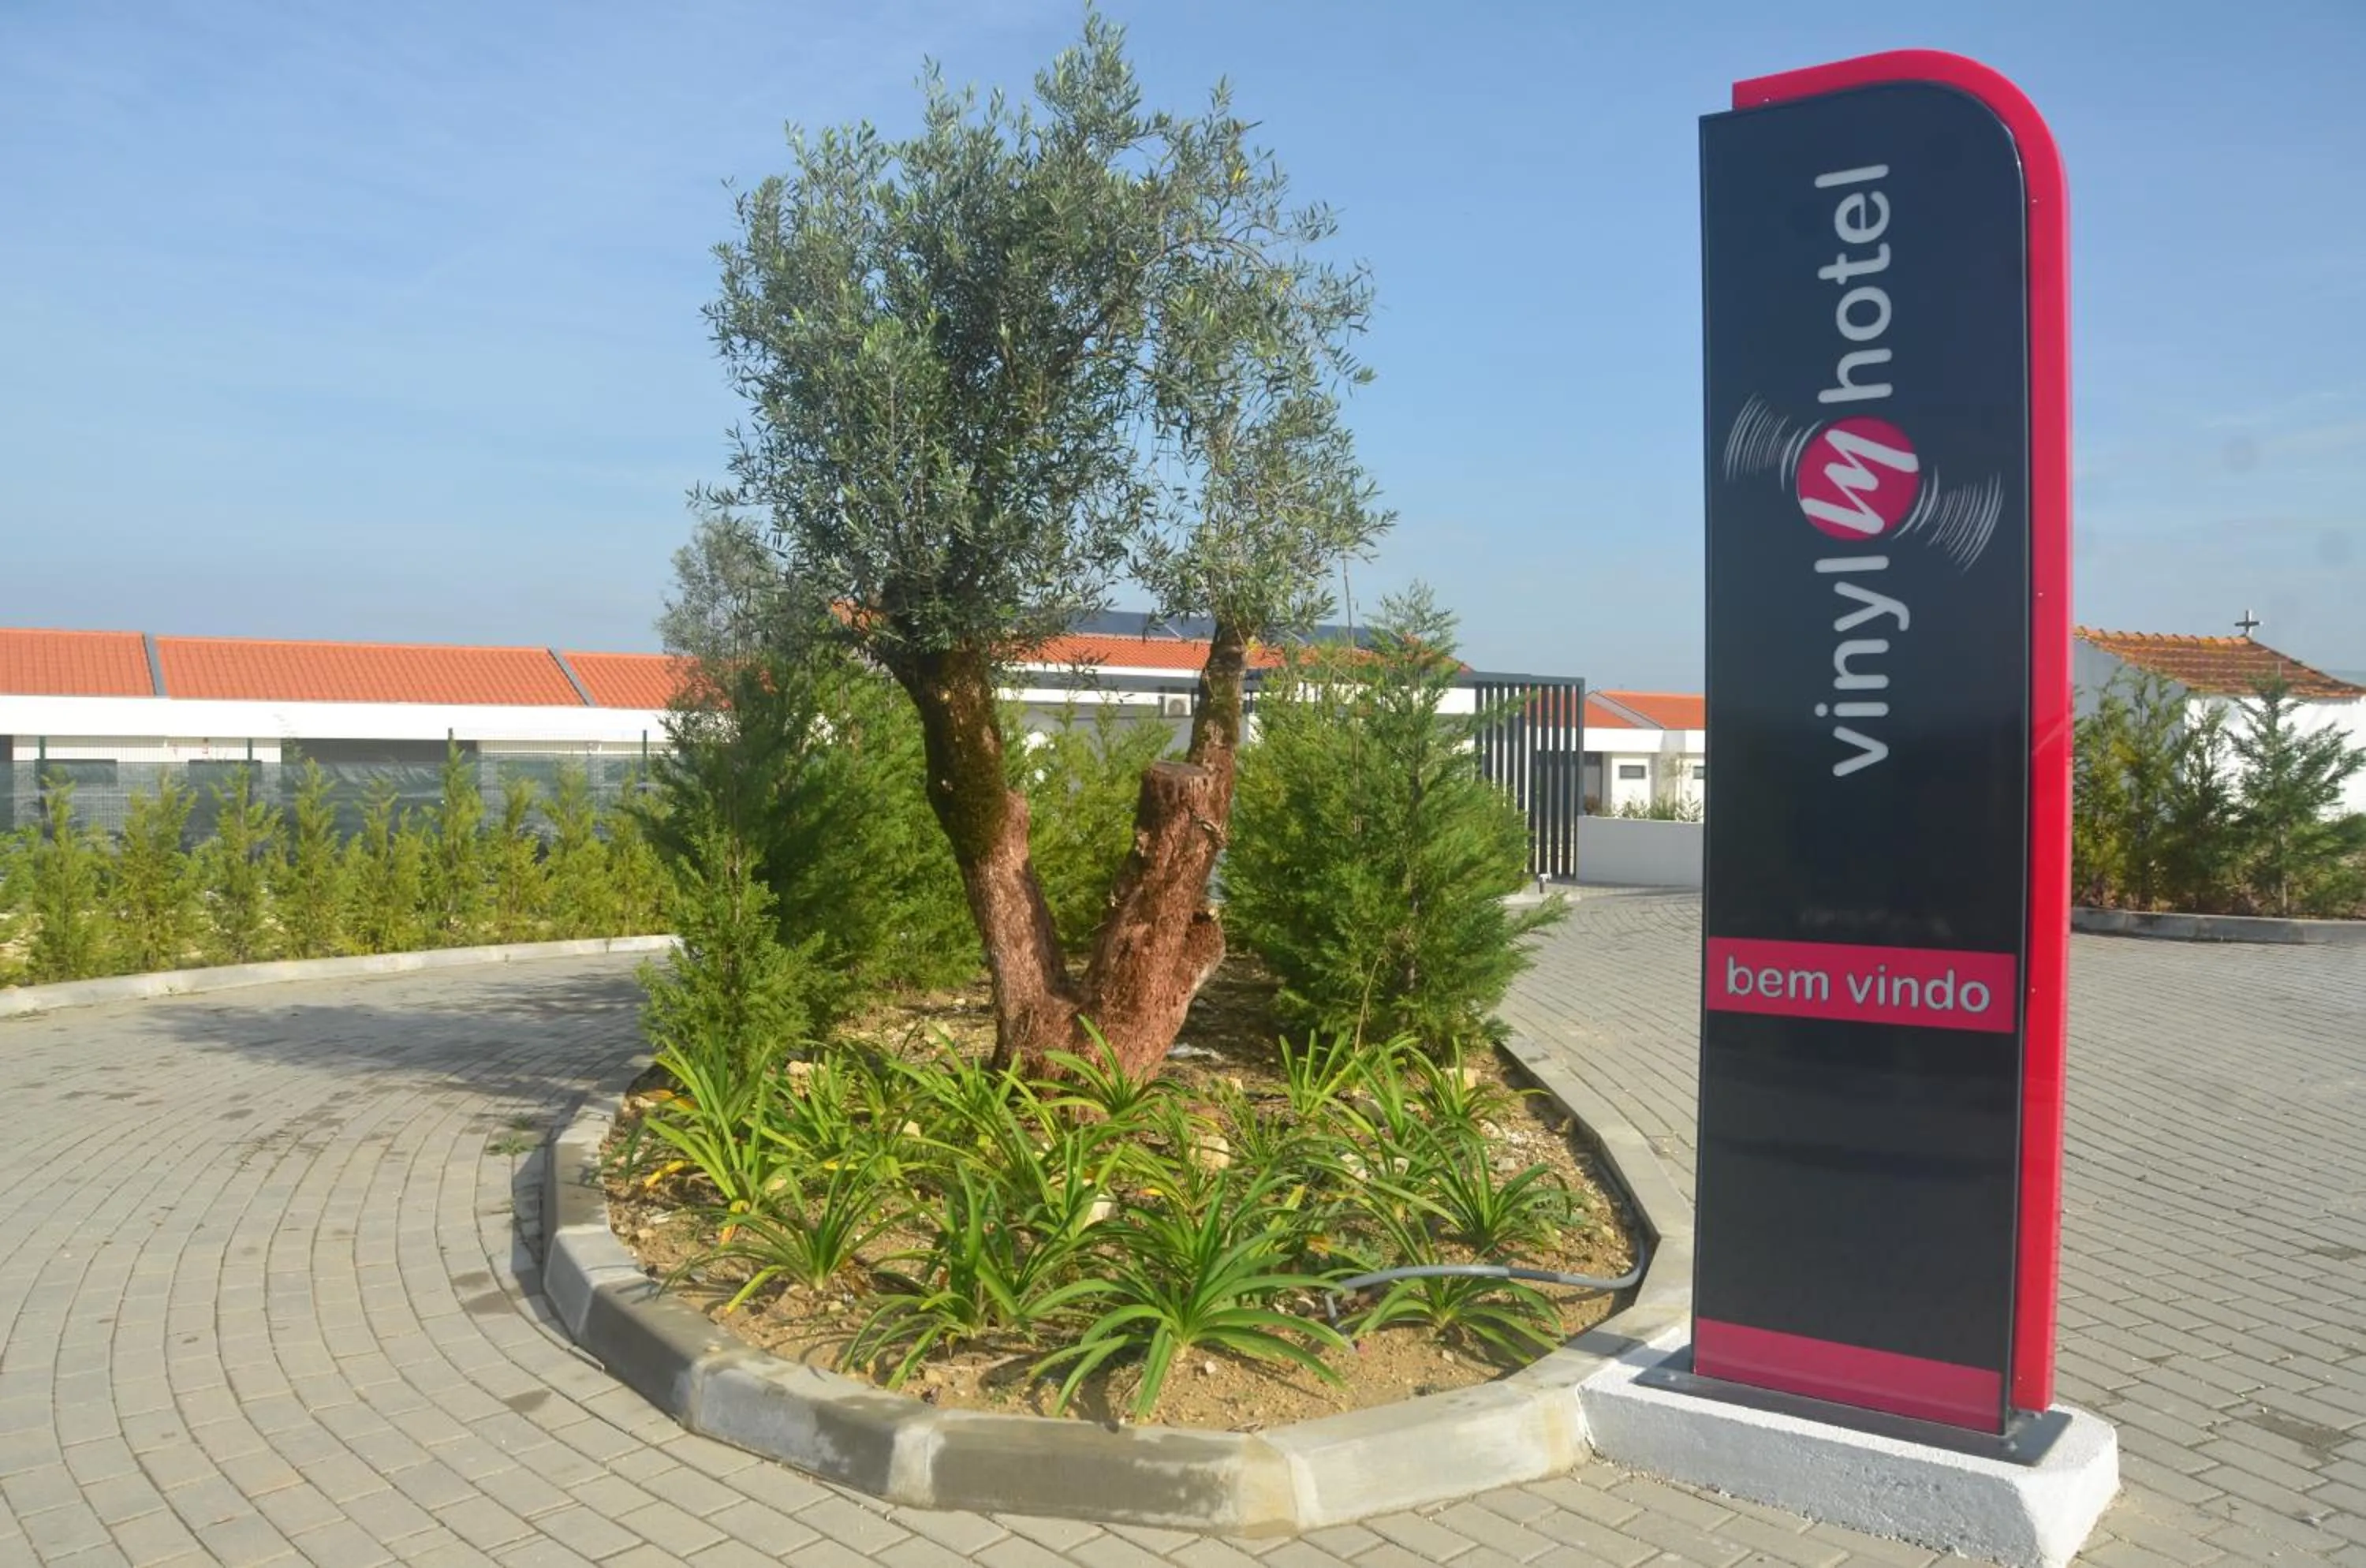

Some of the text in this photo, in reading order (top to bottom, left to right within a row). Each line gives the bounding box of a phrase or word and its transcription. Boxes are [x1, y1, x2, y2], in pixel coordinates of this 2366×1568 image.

[1814, 164, 1892, 403] hotel
[1815, 555, 1909, 777] vinyl
[1726, 956, 1991, 1012] bem vindo
